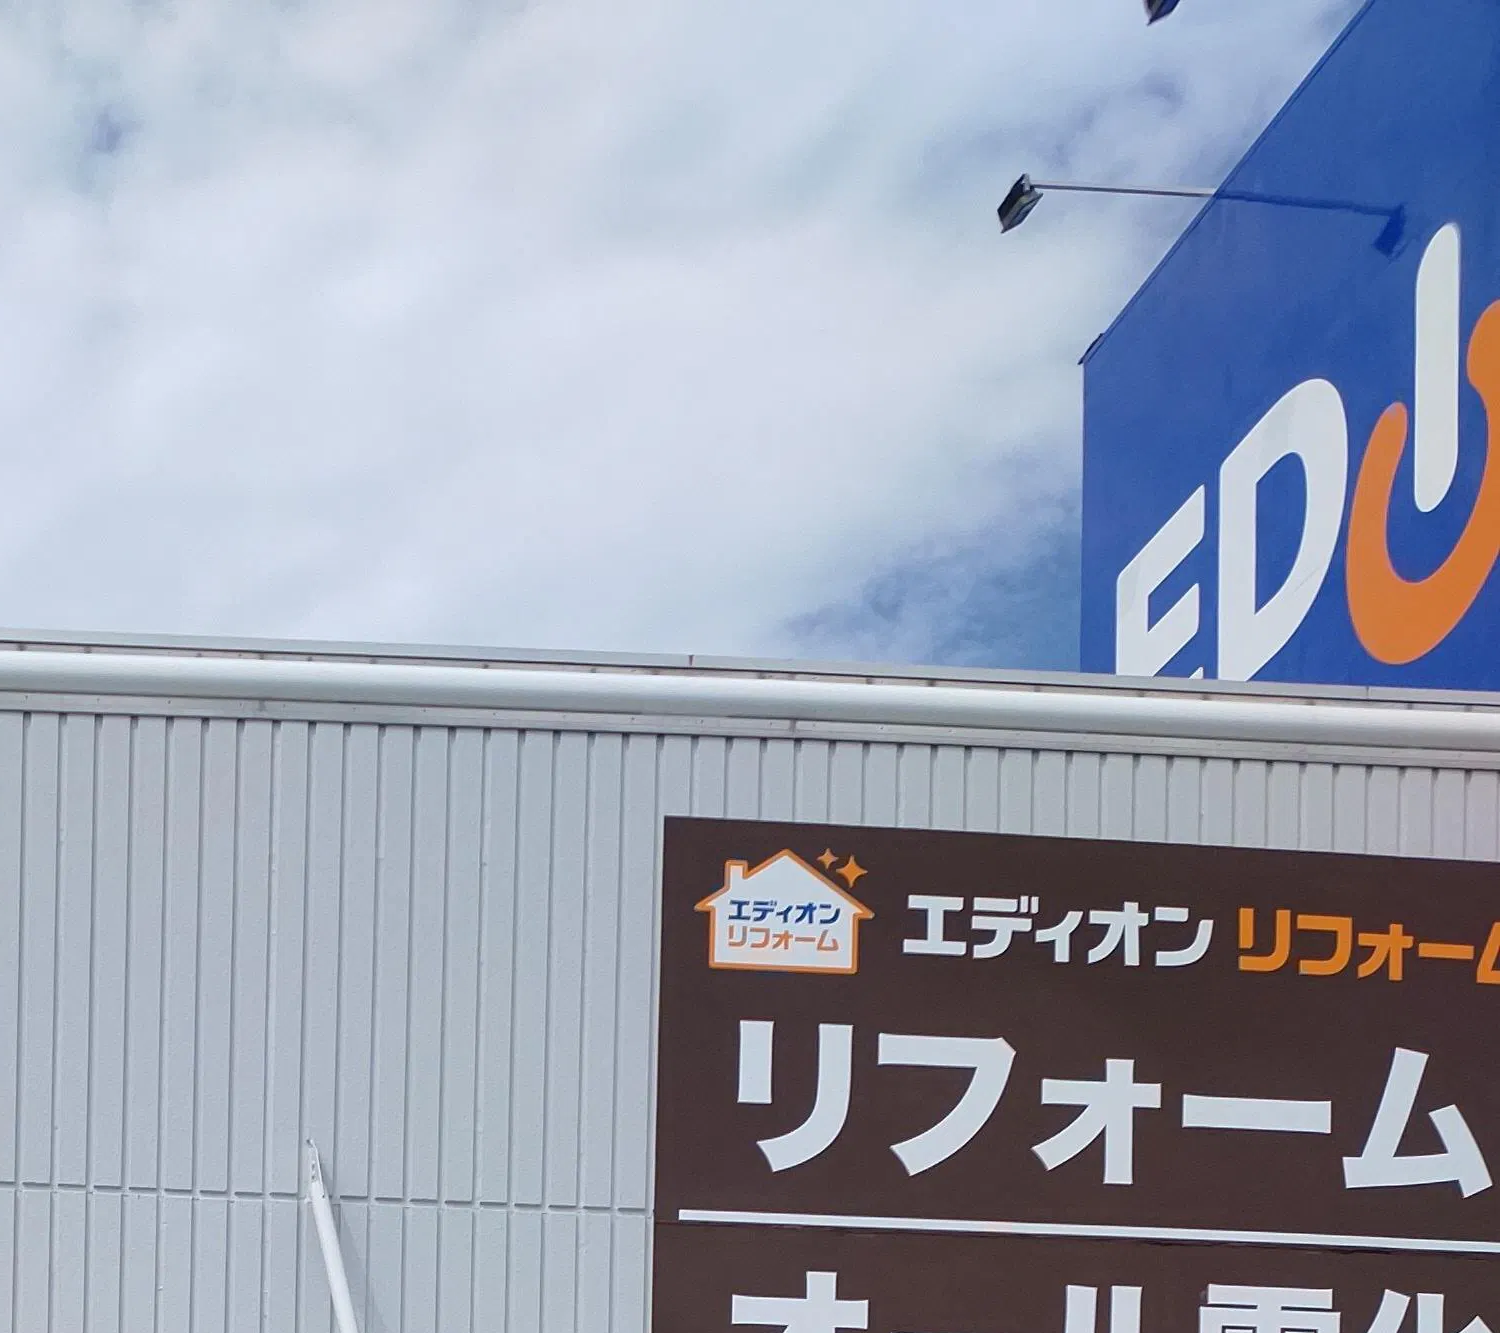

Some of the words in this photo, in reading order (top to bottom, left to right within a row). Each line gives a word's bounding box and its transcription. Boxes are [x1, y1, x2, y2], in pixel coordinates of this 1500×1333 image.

[1116, 223, 1500, 682] EDIO
[728, 899, 840, 925] エディオン
[728, 925, 839, 952] リフォーム
[902, 893, 1216, 967] エディオン
[737, 1020, 1494, 1199] リフォーム
